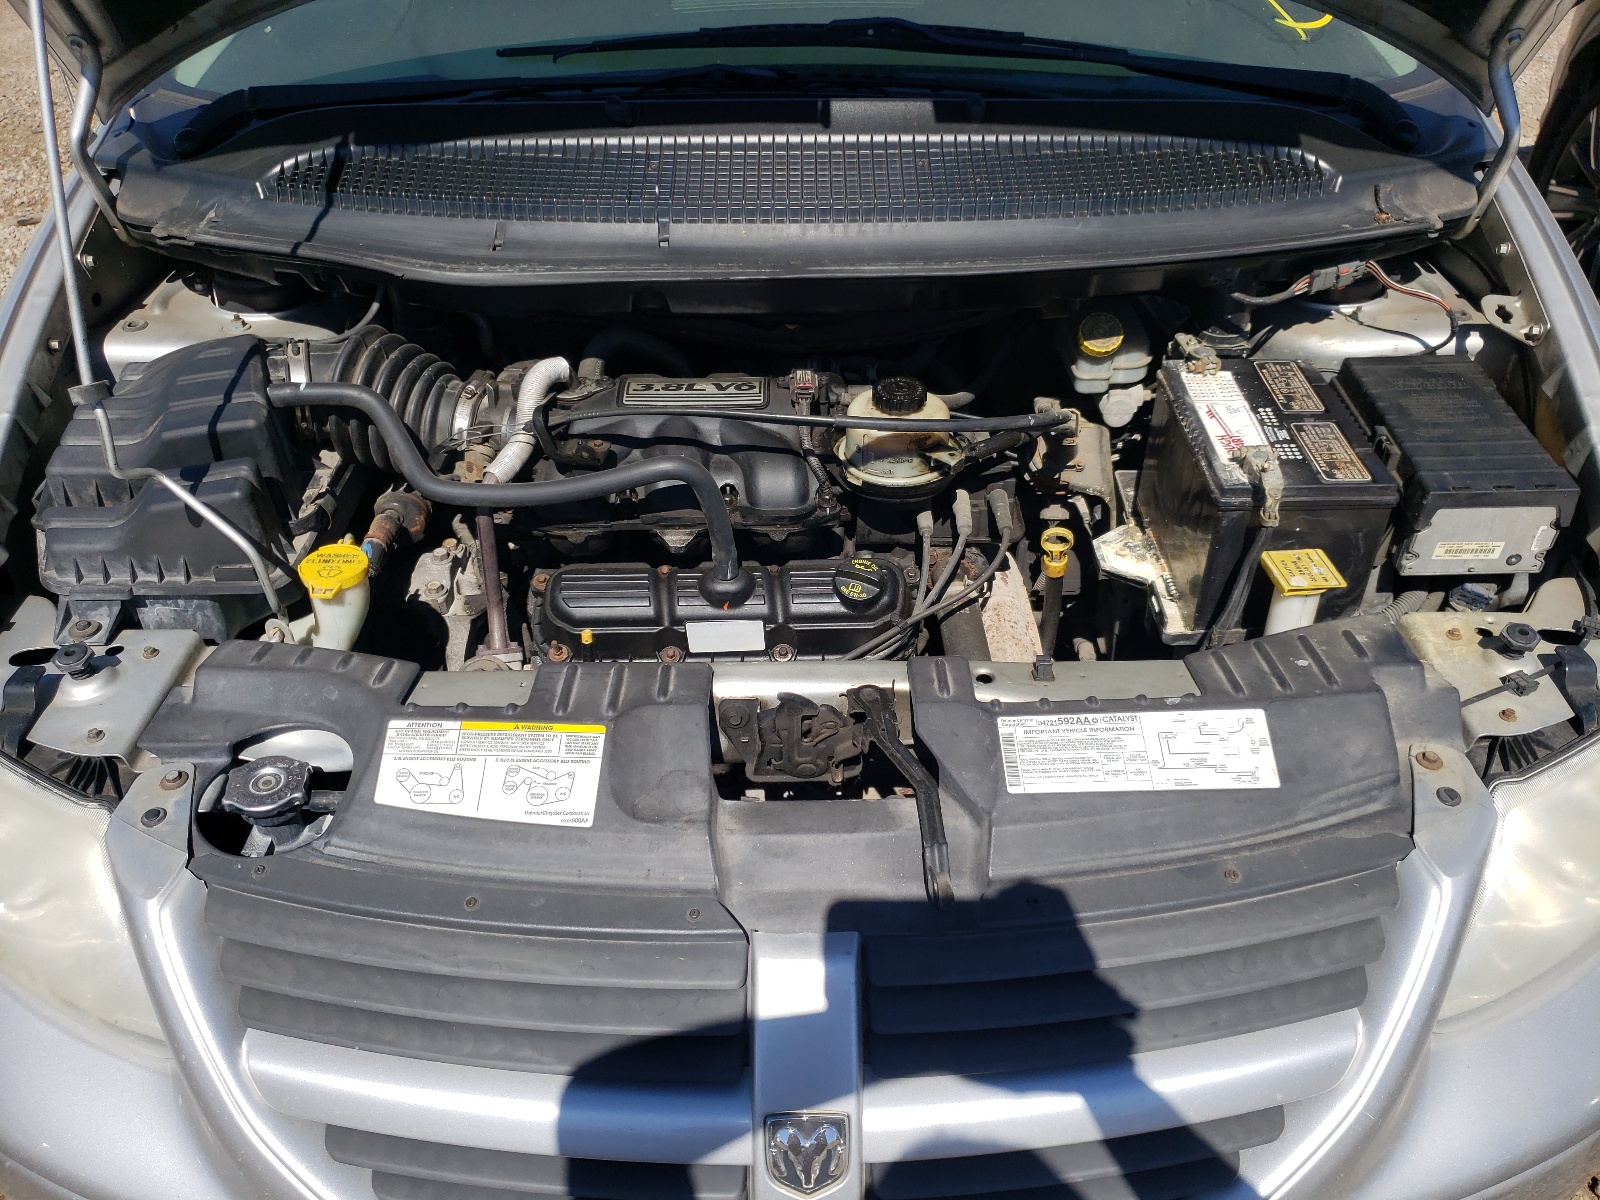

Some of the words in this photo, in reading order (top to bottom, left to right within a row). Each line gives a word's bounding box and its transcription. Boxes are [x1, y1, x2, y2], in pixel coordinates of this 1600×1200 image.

[632, 382, 706, 392] 3.8L
[710, 382, 757, 392] V6
[1102, 714, 1138, 723] CATALYST
